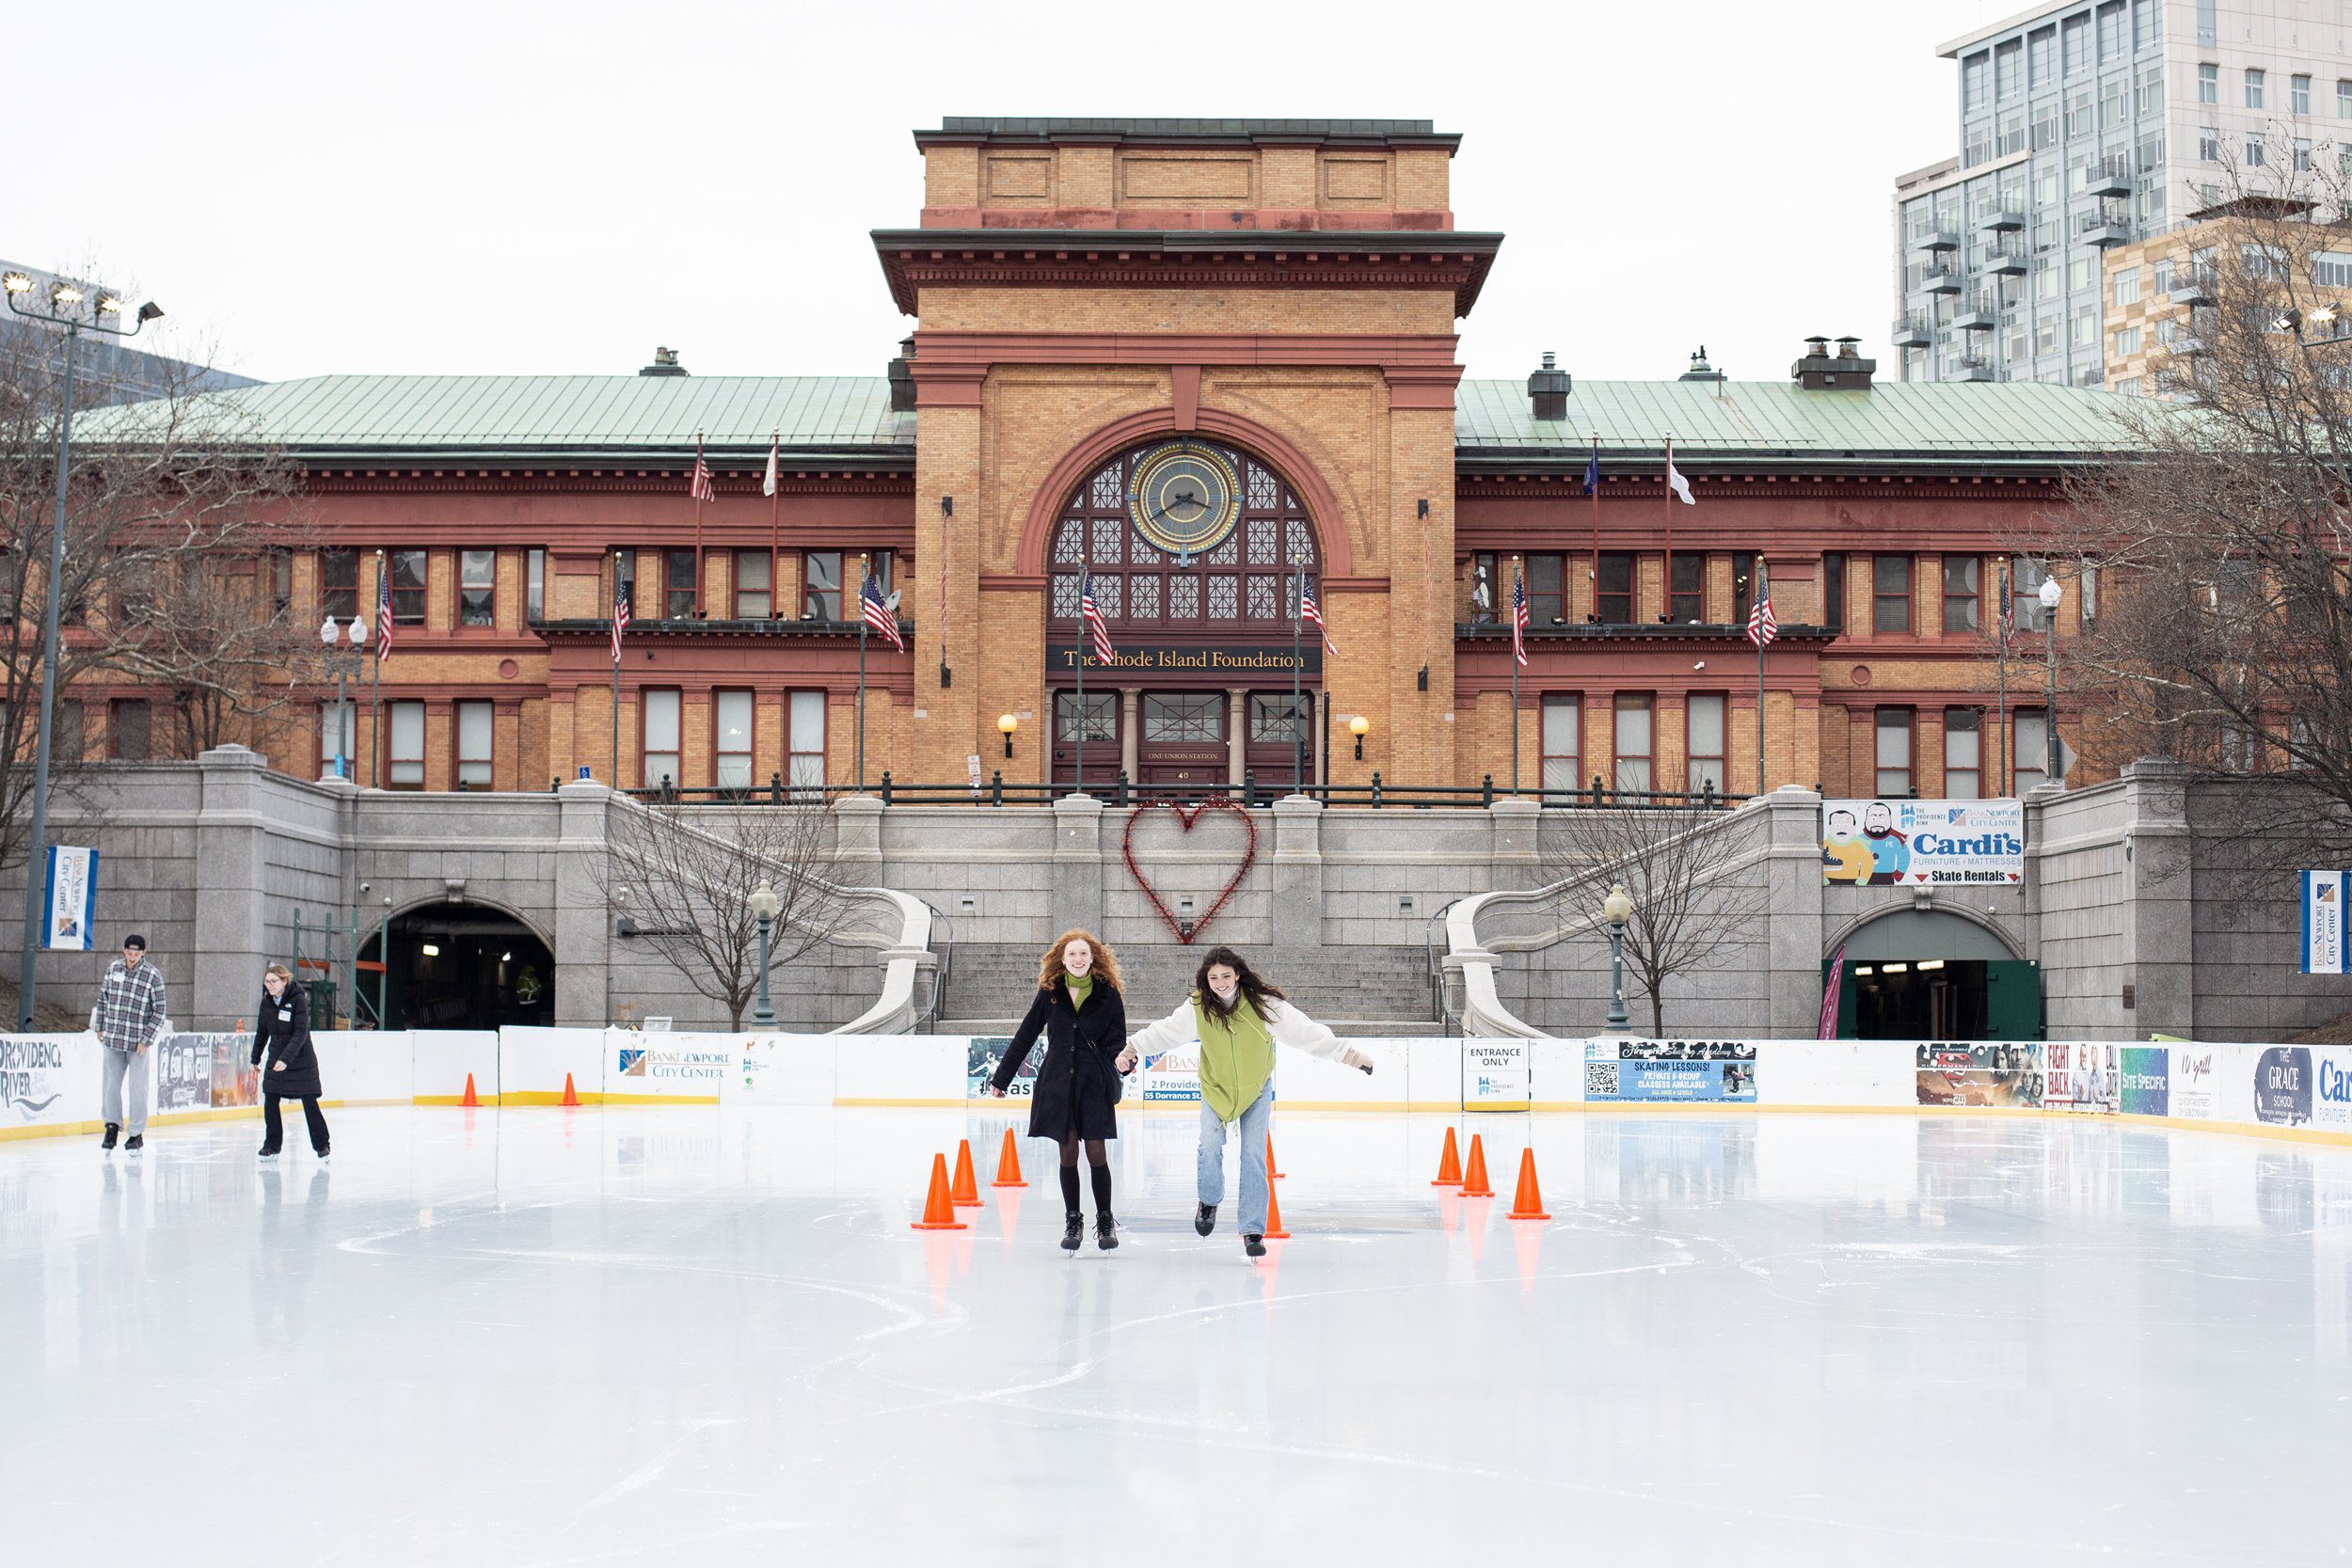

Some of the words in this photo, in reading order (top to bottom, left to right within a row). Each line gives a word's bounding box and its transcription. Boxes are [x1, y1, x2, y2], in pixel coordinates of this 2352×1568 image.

[1100, 650, 1152, 667] hode
[1157, 650, 1207, 667] Island
[1212, 651, 1304, 667] Foundation
[1914, 832, 2022, 856] Cardi's
[60, 856, 72, 876] City
[1931, 870, 1962, 881] Skate
[1964, 870, 2005, 881] Rentals
[59, 878, 71, 911] Center
[2327, 909, 2335, 942] Center
[2327, 945, 2338, 964] City
[647, 1050, 730, 1064] BANKEWPORT
[2048, 1044, 2070, 1069] FIGHT
[2280, 1050, 2290, 1062] THE
[653, 1065, 678, 1078] CITY
[680, 1065, 724, 1079] CENTER
[1634, 1062, 1670, 1070] SKATING
[1672, 1062, 1710, 1071] LESSONS!
[1152, 1080, 1157, 1088] 2
[2048, 1071, 2071, 1095] BACK.
[2268, 1066, 2299, 1090] GRACE
[2273, 1095, 2294, 1108] SCHOOL
